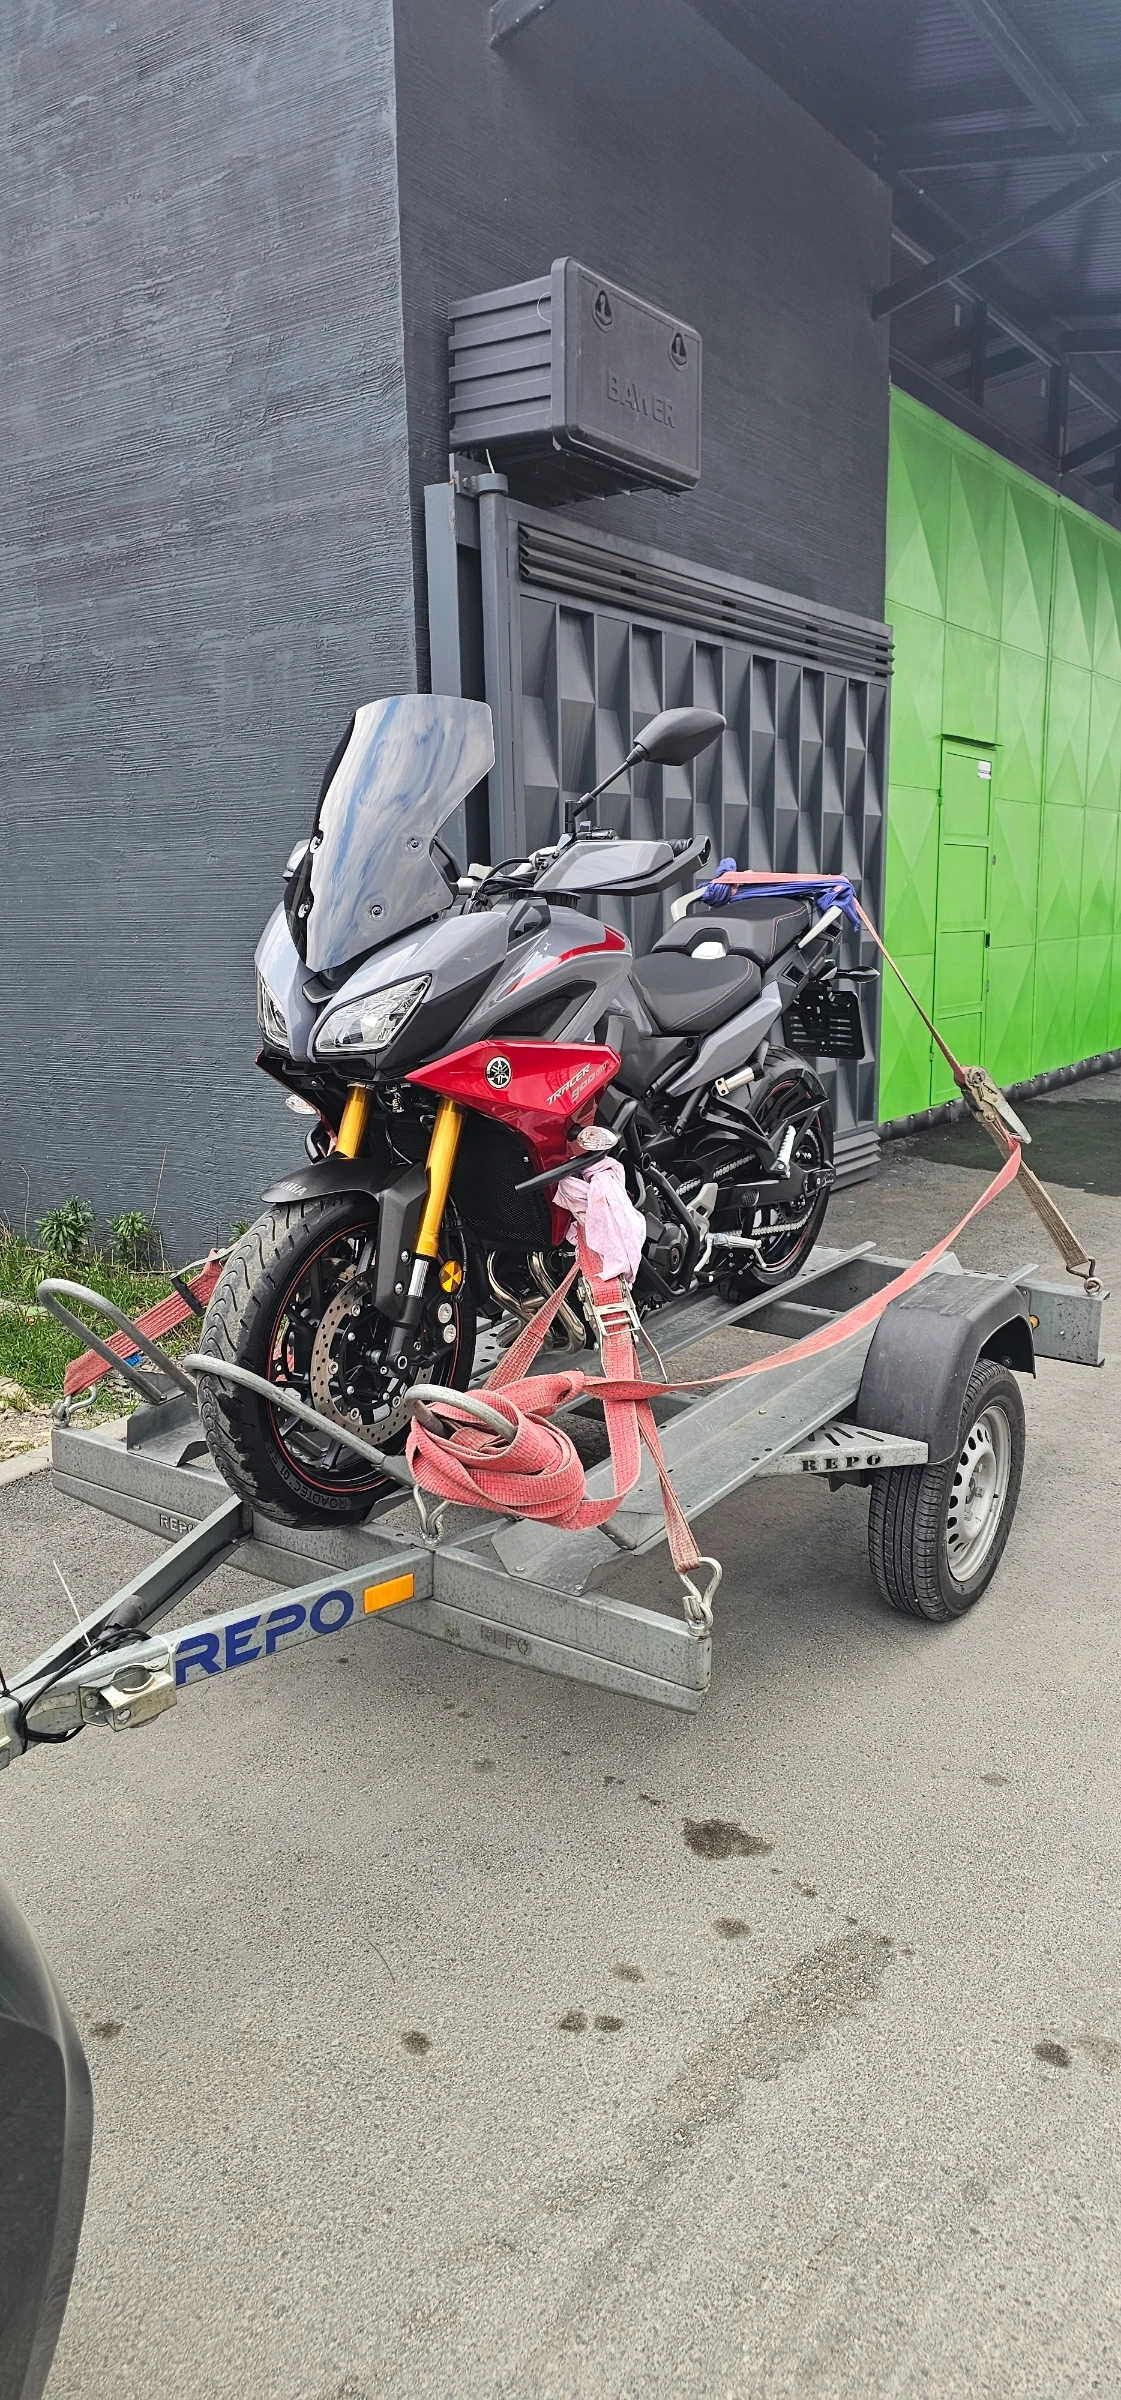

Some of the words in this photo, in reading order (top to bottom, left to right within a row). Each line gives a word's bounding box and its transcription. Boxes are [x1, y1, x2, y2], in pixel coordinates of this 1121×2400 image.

[606, 369, 675, 429] BAWER
[547, 1063, 591, 1106] TRACER
[572, 1072, 596, 1103] 900
[801, 1454, 881, 1472] REPO
[175, 1589, 354, 1687] REPO
[480, 1624, 532, 1656] REPO
